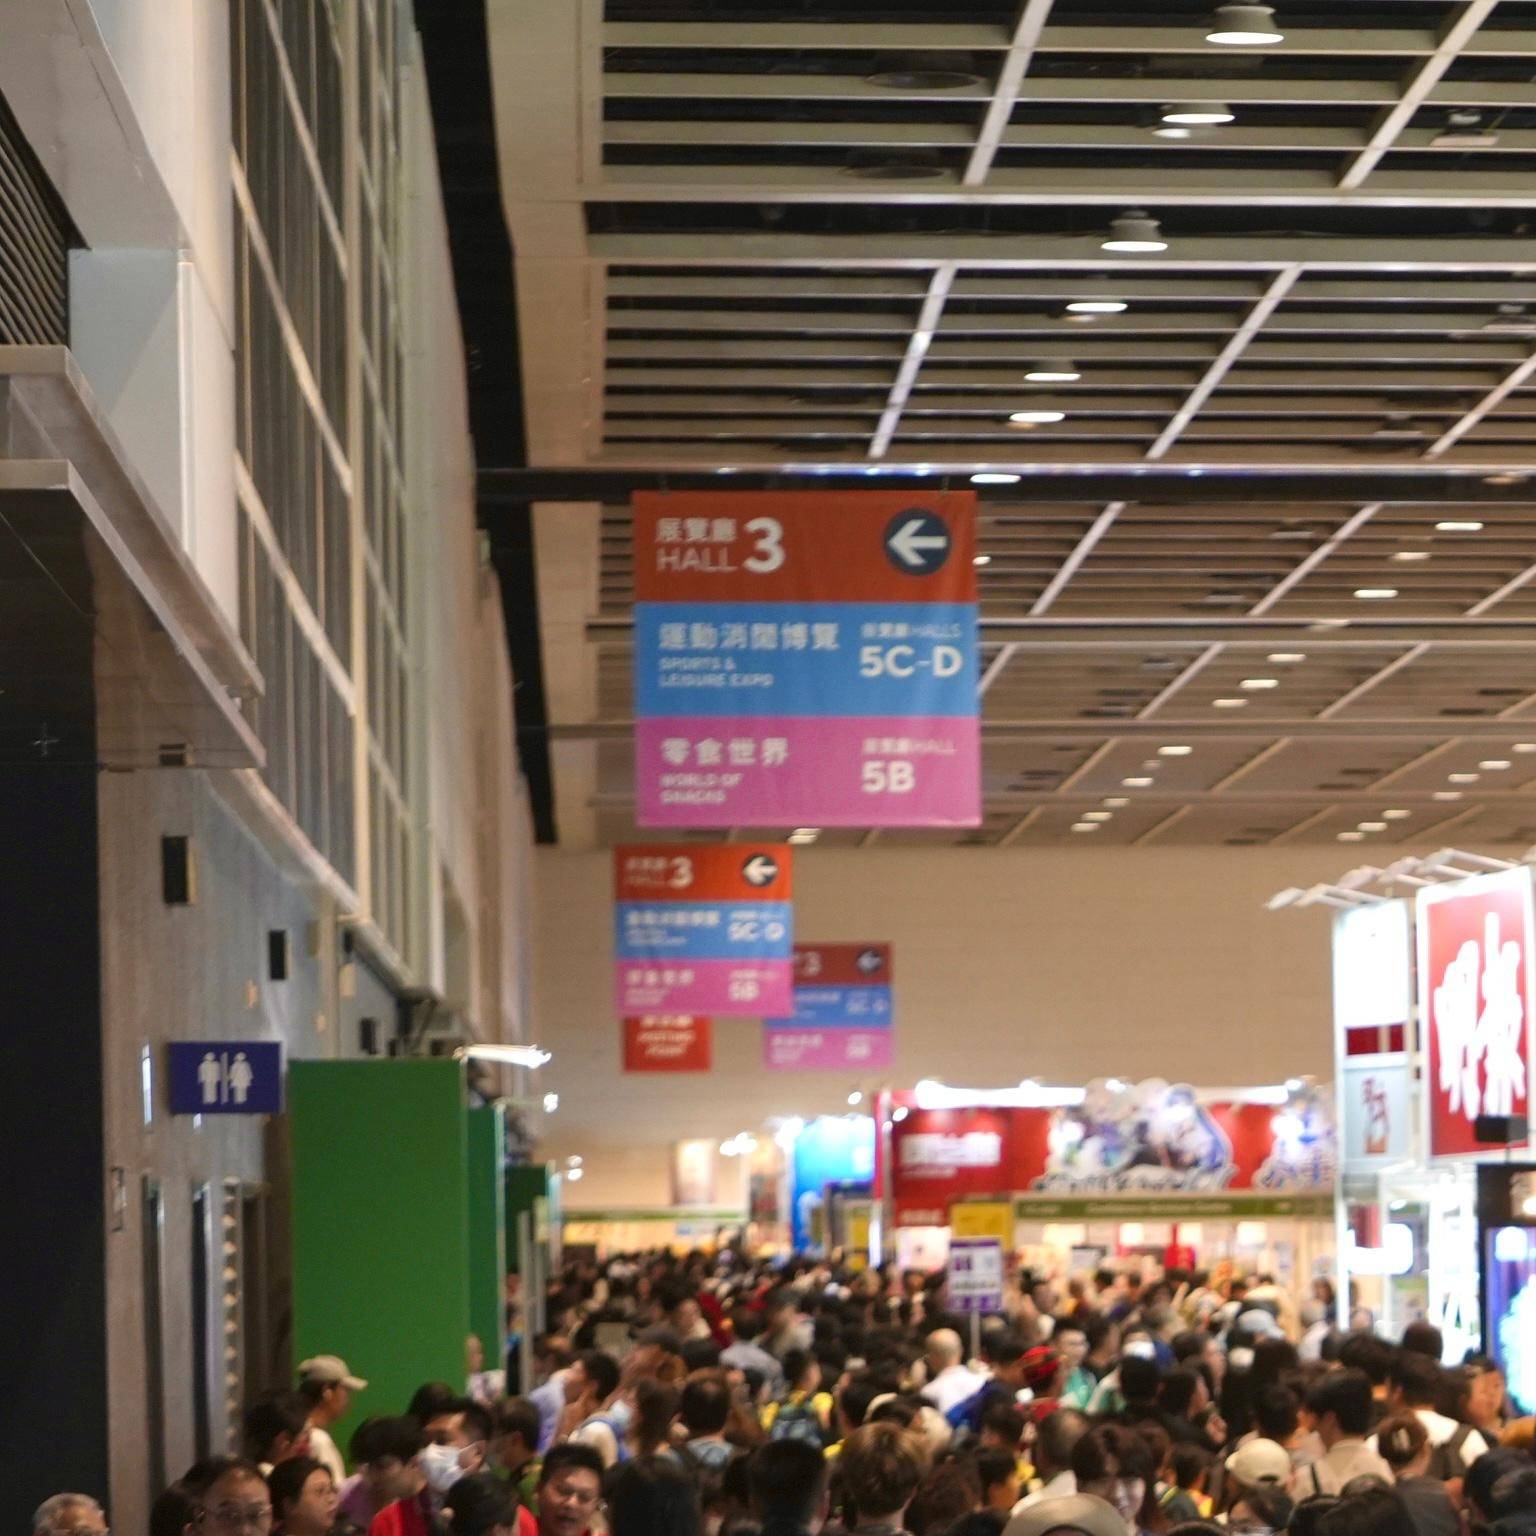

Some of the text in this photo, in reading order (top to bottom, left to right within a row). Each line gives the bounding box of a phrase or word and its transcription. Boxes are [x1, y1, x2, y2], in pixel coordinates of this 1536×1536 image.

[656, 516, 738, 543] 展覽廳
[656, 547, 738, 573] HALL
[743, 516, 786, 574] 3
[859, 645, 963, 678] 5C-D
[659, 673, 728, 687] LEISURE
[661, 737, 789, 766] 零食世界
[861, 761, 916, 793] 5B
[671, 856, 693, 889] 3
